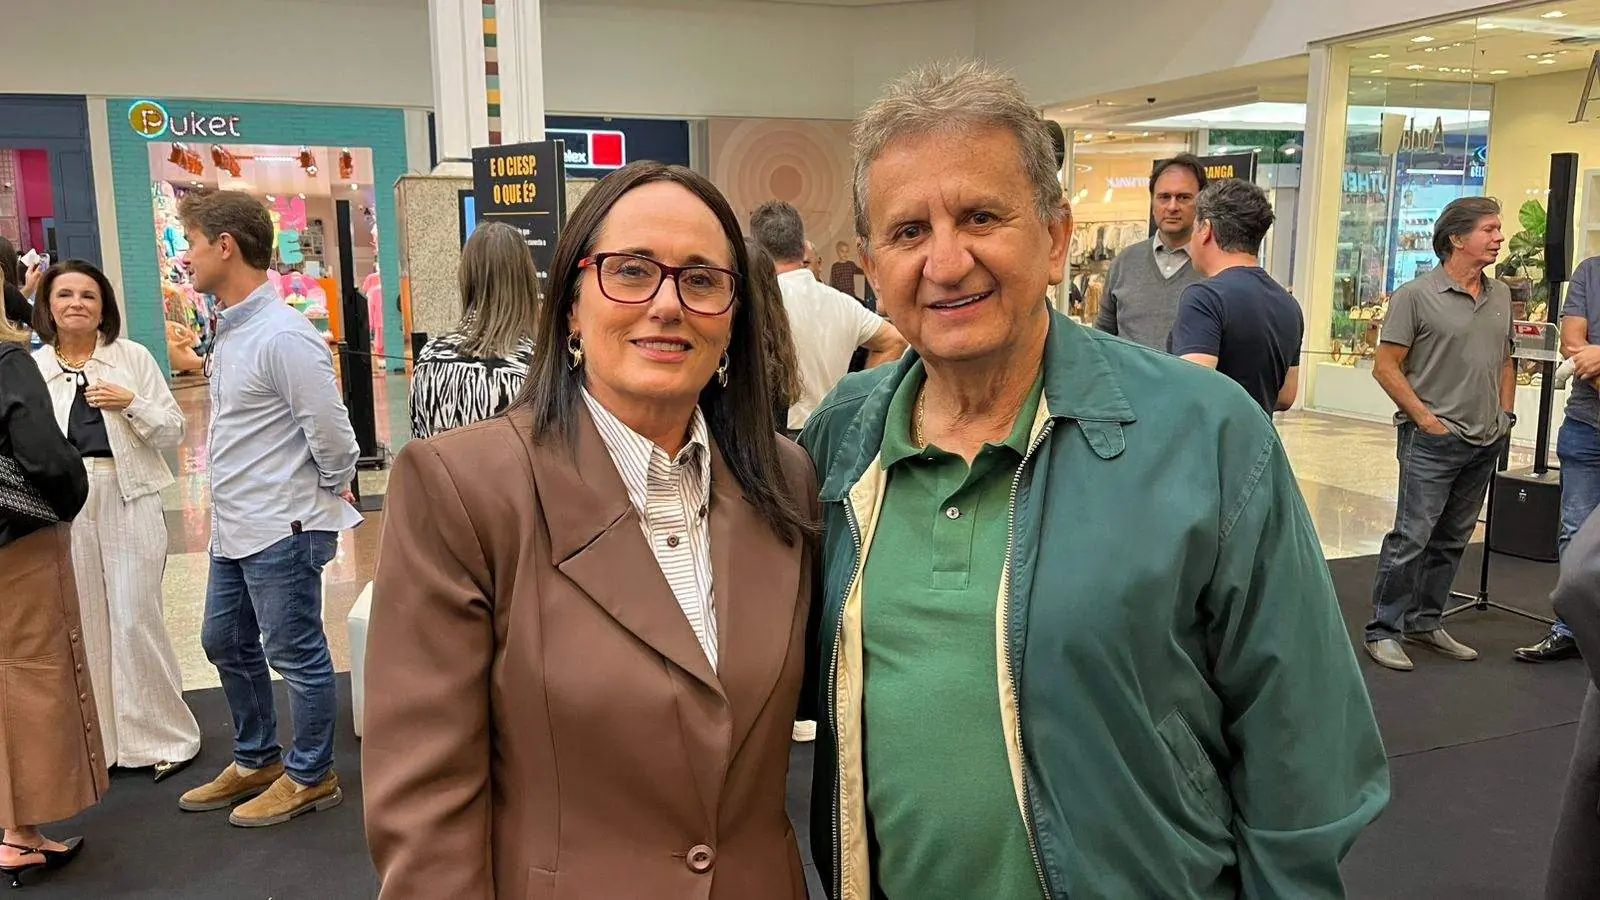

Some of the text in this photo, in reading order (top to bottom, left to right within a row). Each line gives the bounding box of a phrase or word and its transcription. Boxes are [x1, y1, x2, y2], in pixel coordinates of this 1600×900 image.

[141, 109, 241, 136] Puket
[490, 154, 537, 177] E O CIESP,
[493, 180, 536, 206] O QUE É?
